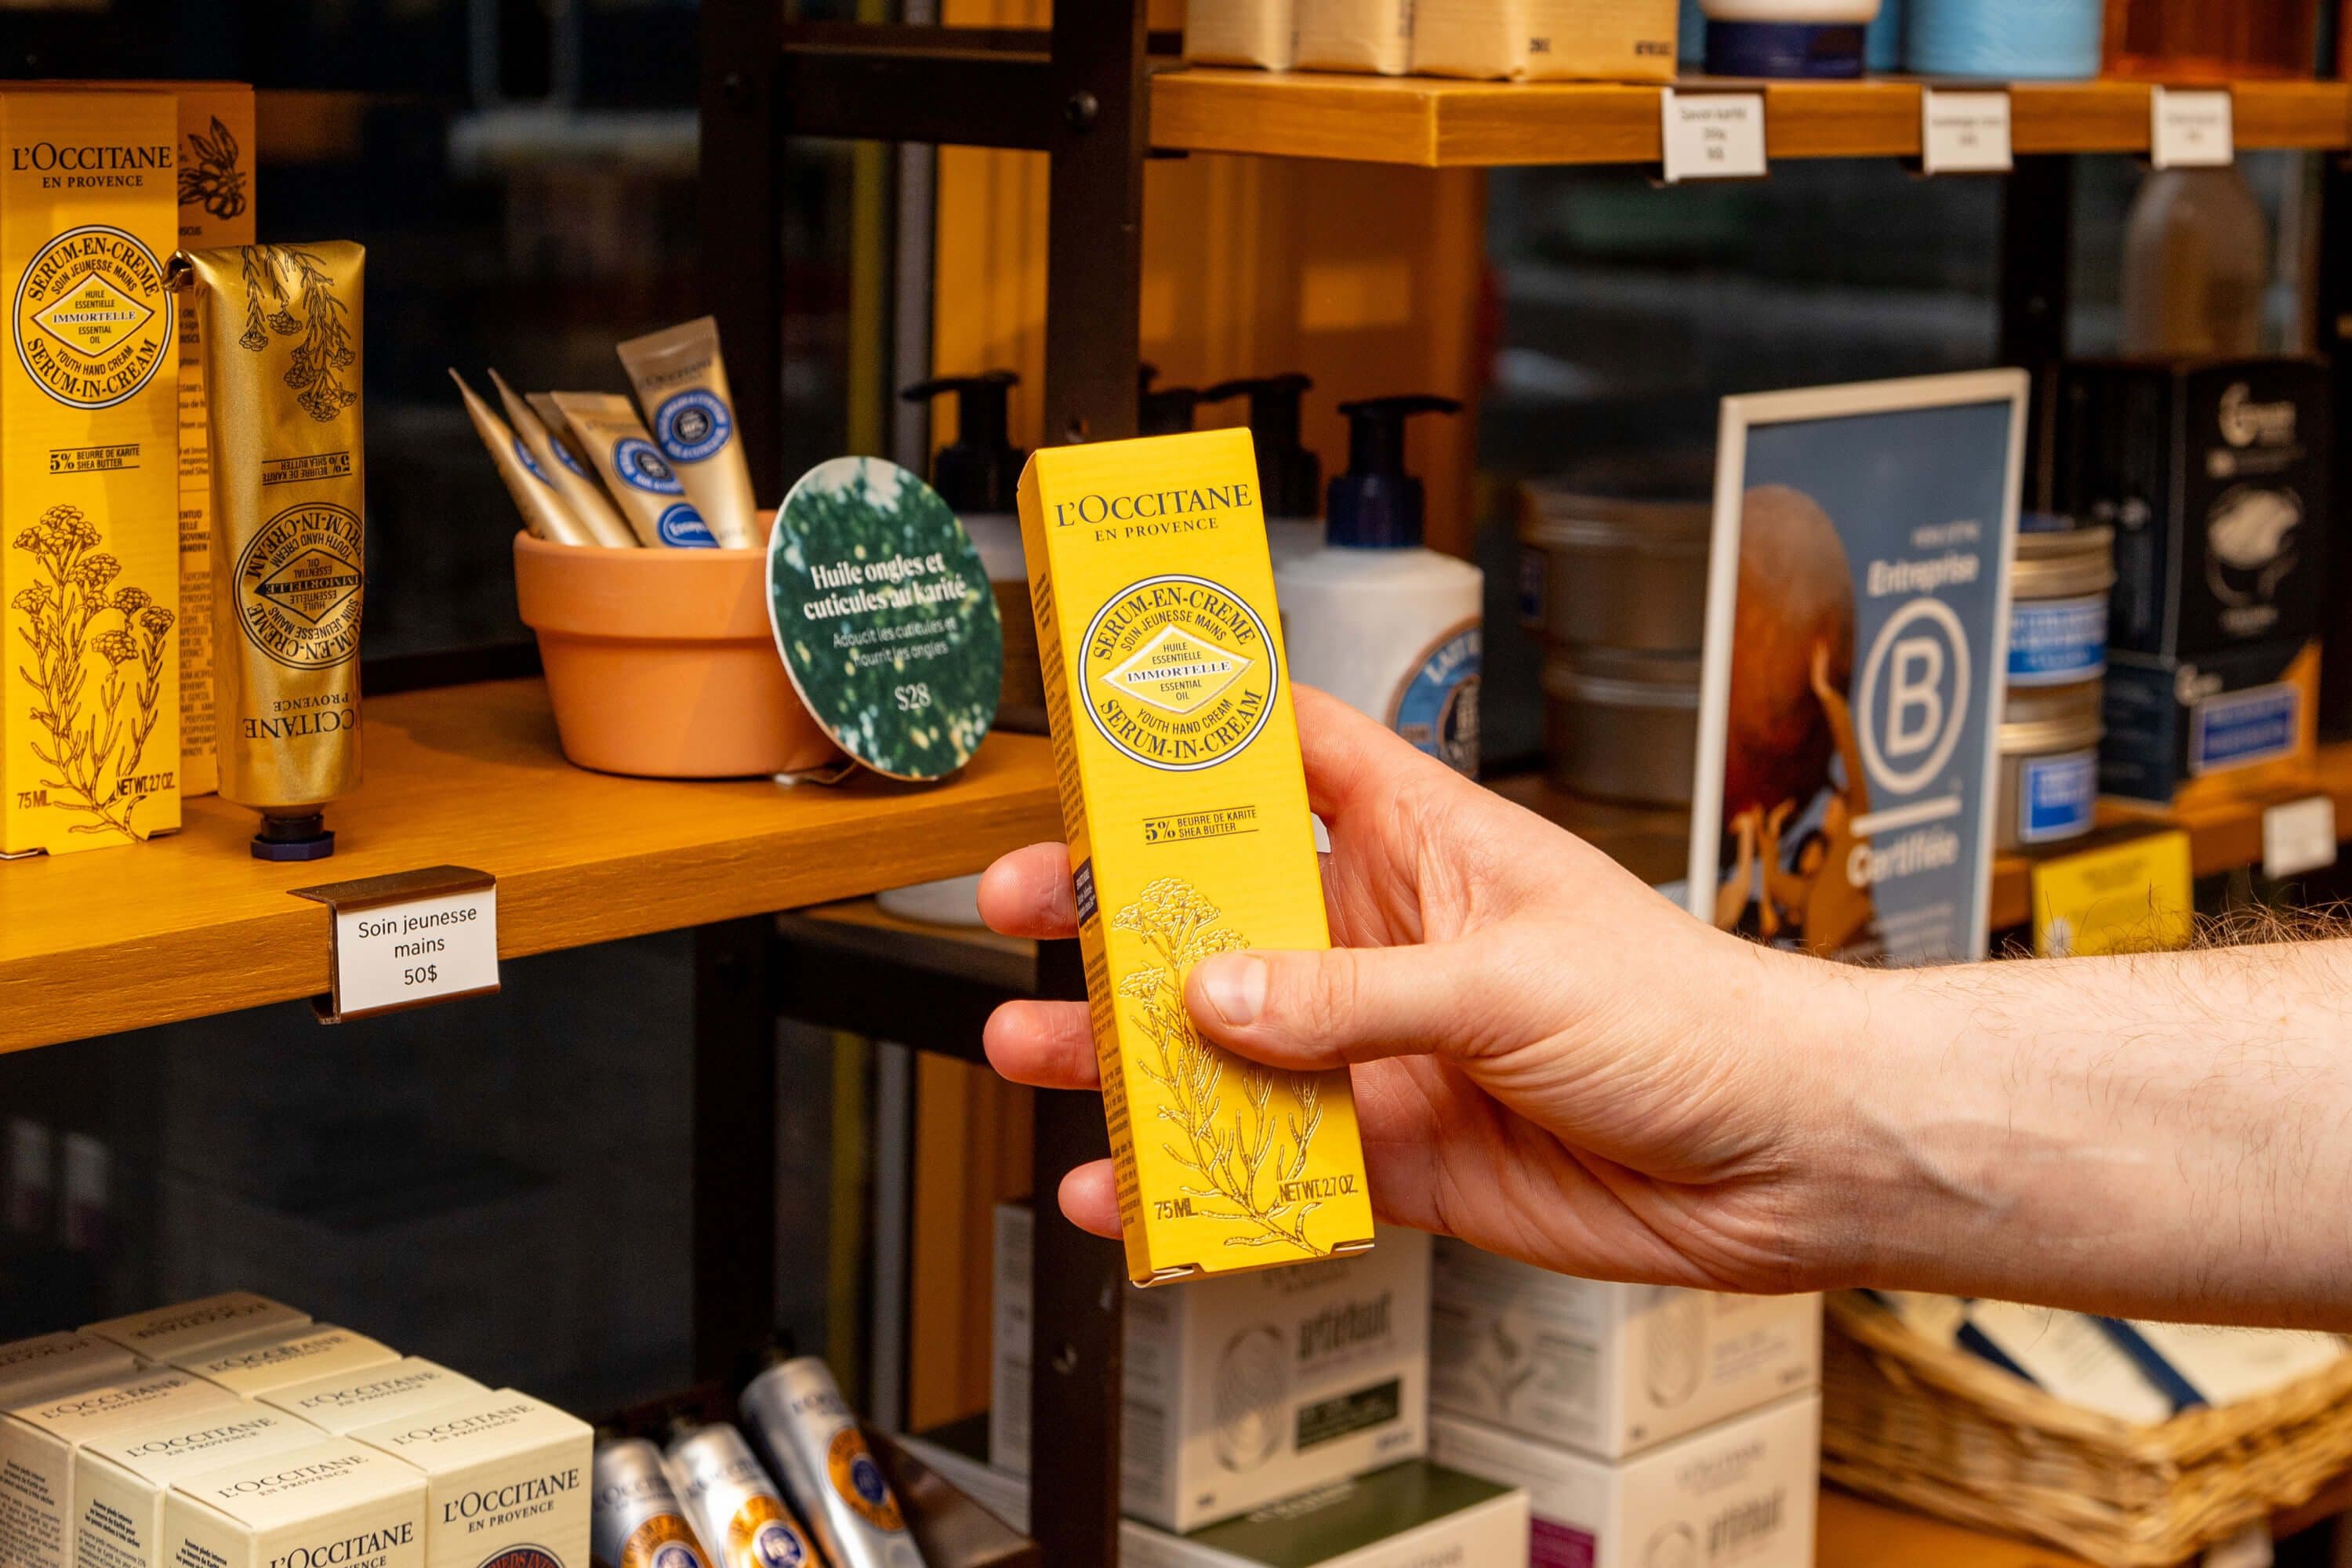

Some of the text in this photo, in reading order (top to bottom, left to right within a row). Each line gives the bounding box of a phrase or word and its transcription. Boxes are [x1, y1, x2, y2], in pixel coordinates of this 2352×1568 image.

[13, 142, 172, 171] L'OCCITANE
[42, 175, 144, 188] EN PROVENCE
[28, 237, 160, 302] SERUM-EN-CREME
[51, 259, 137, 295] SOIN JEUNESSE MAINS
[74, 299, 115, 309] ESSENTIELLE
[85, 289, 105, 299] HUILE
[53, 310, 136, 323] IMMORTELLE
[78, 325, 111, 335] ESSENTIAL
[89, 336, 101, 344] OIL
[27, 337, 158, 398] SERUM-IN-CREAM
[56, 344, 135, 376] YOUTH HAND CREAM
[50, 452, 74, 471] 5%
[77, 449, 103, 460] BEURRE
[105, 448, 114, 459] DE
[77, 458, 123, 470] SHEA BUTTER
[281, 456, 328, 470] SHEA BUTTER
[288, 470, 299, 480] DE
[1054, 484, 1253, 528] L'OCCITANE
[1094, 517, 1219, 542] EN PROVENCE
[245, 513, 362, 580] RUM-IN-CREAM
[270, 532, 352, 568] YOUTH HAND CREAM
[294, 564, 332, 579] ESSENTIAL
[307, 557, 320, 566] OIL
[810, 551, 946, 590] Huile ongles et
[289, 590, 337, 604] ESSENTIELLE
[804, 573, 967, 620] cuticules au karité
[247, 602, 361, 660] UM-EN-CREME
[269, 598, 359, 641] SOIN JEUNESSE MAINS
[833, 626, 877, 648] Adoucit
[877, 625, 895, 641] les
[896, 619, 944, 640] cuticules
[1093, 586, 1255, 661] SERUM-EN-CREME
[1121, 609, 1227, 652] SOIN JEUNESSE MAINS
[911, 641, 949, 659] ongles
[1152, 651, 1202, 665] ESSENTIELLE
[1163, 642, 1188, 653] HUILE
[1127, 661, 1231, 682] IMMORTELLE
[1160, 680, 1202, 692] ESSENTIAL
[1175, 691, 1190, 701] OIL
[273, 692, 350, 713] PROVENCE
[242, 708, 356, 739] CCITANE
[1099, 689, 1263, 760] SERUM-IN-CREAM
[1136, 699, 1233, 735] YOUTH HAND CREAM
[1145, 809, 1257, 841] 5% BEURRE DE KARITE
[1179, 822, 1236, 838] SHEA BUTTER
[358, 907, 477, 938] Soin jeunesse
[394, 938, 445, 959] mains
[404, 964, 437, 985] 50$
[125, 1417, 278, 1458] L'OCCITANE
[390, 1403, 535, 1446] L'OCCITANE
[432, 1417, 519, 1444] EN PROVENCE
[188, 1431, 261, 1452] PROVENCE
[217, 1454, 370, 1499] L'OCCITANE
[257, 1468, 354, 1497] EN PROVENCE
[442, 1468, 581, 1524] L'OCCITANE
[468, 1500, 555, 1534] EN PROVENCE
